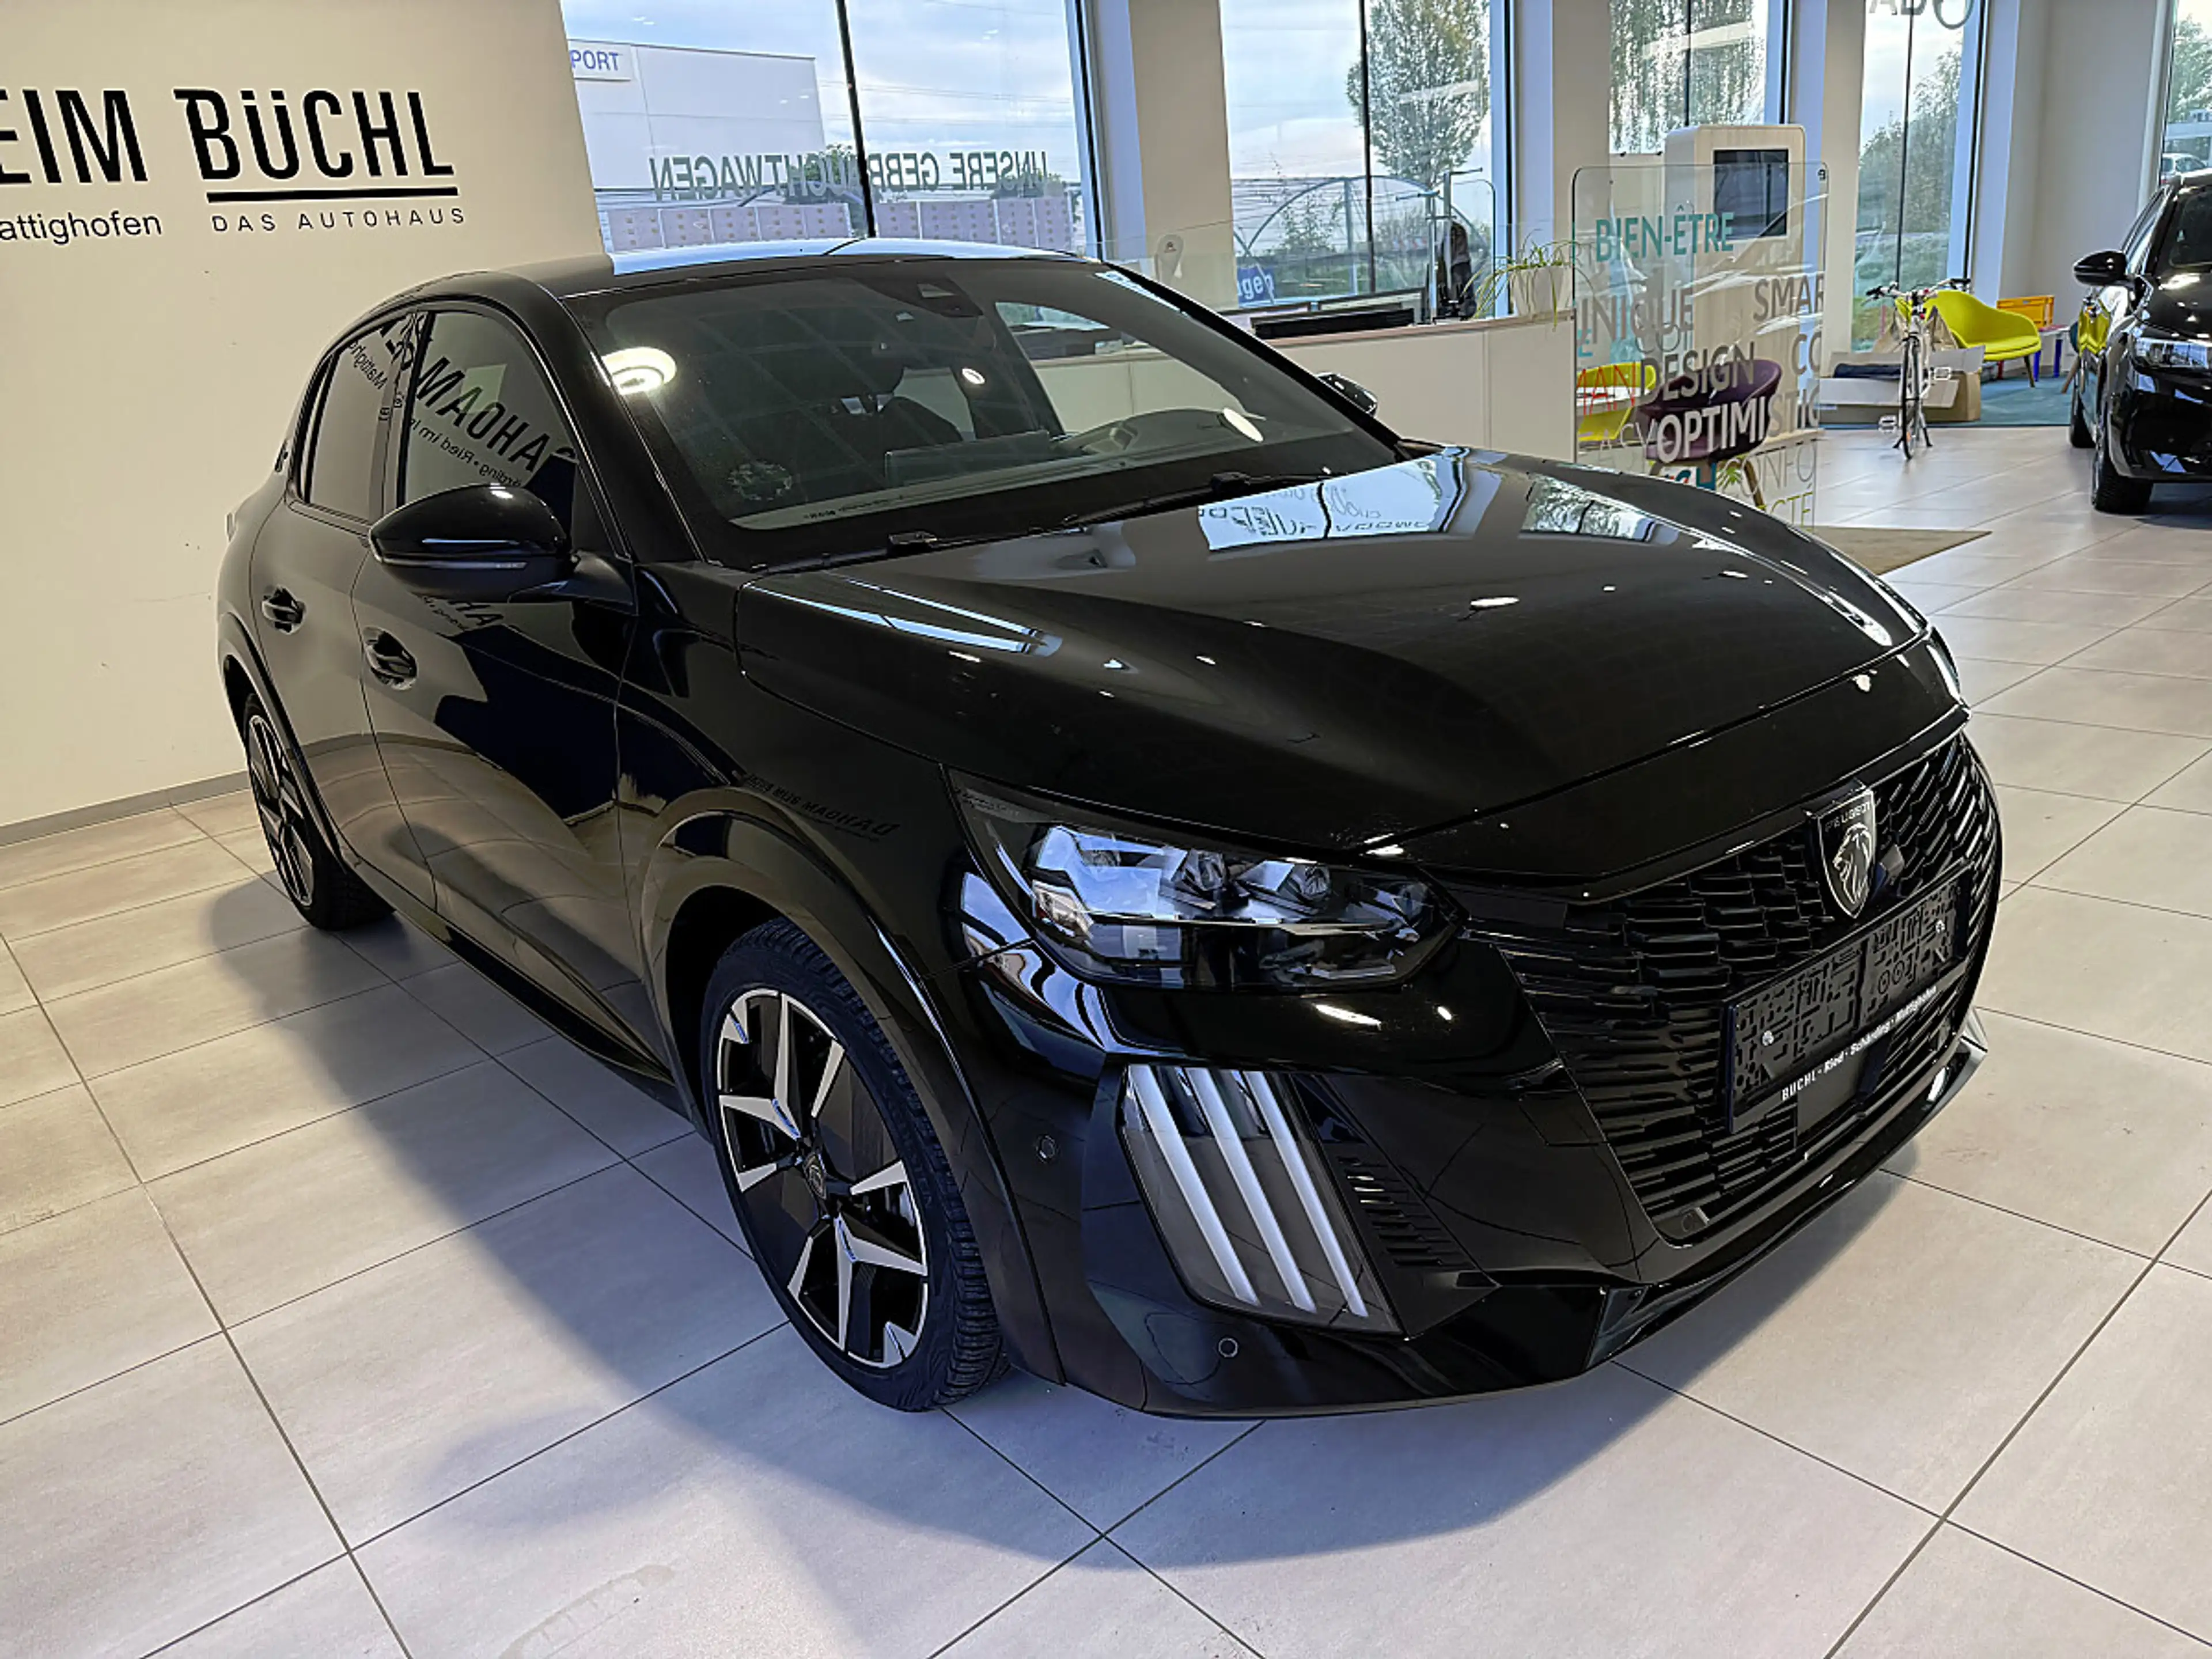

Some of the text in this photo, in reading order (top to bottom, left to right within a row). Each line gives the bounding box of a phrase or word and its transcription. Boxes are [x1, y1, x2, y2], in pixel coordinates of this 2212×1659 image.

[173, 89, 455, 180] BÜCHL
[212, 208, 463, 231] DAS AUTOHAUS
[1596, 204, 1734, 263] BIEN-ÊTRE
[1639, 342, 1755, 406] DESIGN
